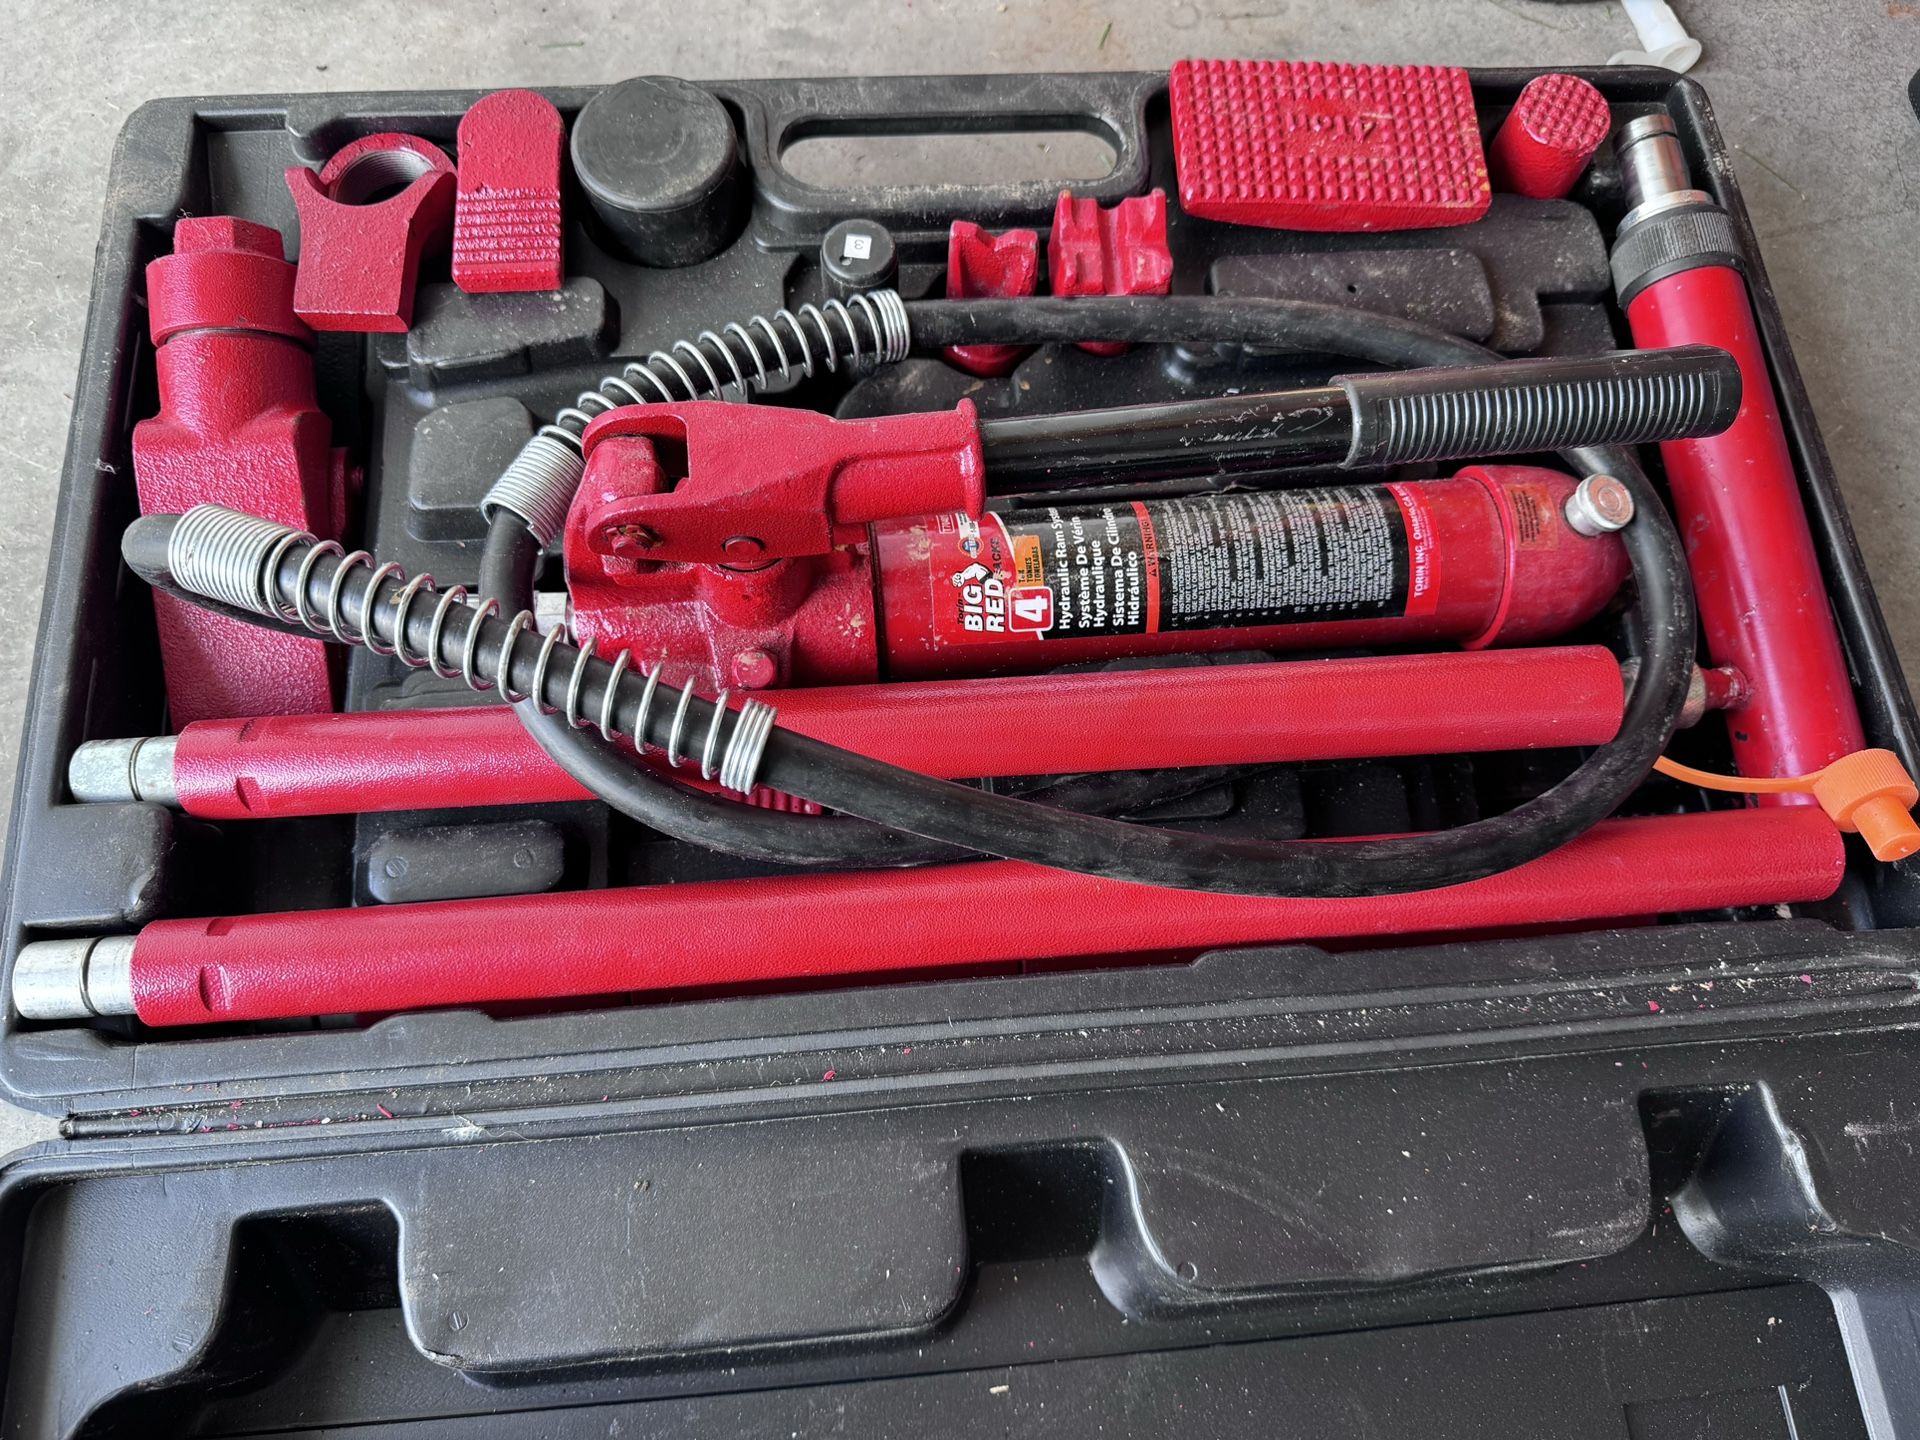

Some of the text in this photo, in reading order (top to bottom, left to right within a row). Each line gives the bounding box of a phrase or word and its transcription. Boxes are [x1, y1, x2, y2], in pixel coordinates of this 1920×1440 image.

[1402, 496, 1413, 507] CA
[1054, 530, 1067, 558] Ram
[1175, 545, 1183, 568] BEFORE
[1221, 540, 1229, 558] DOLLY
[1414, 542, 1424, 563] INC.
[1070, 516, 1093, 629] Système De Vérin
[1101, 507, 1125, 627] Sistema De Cilindro
[1235, 550, 1243, 569] AREAS
[1056, 560, 1073, 630] Hydraulic
[1090, 540, 1108, 628] Hydraulique
[1126, 551, 1140, 626] Hidráulico
[1413, 565, 1425, 598] TORIN
[956, 599, 965, 625] Torin
[963, 584, 983, 632] BIG
[984, 578, 1005, 633] RED
[1014, 595, 1048, 623] 4
